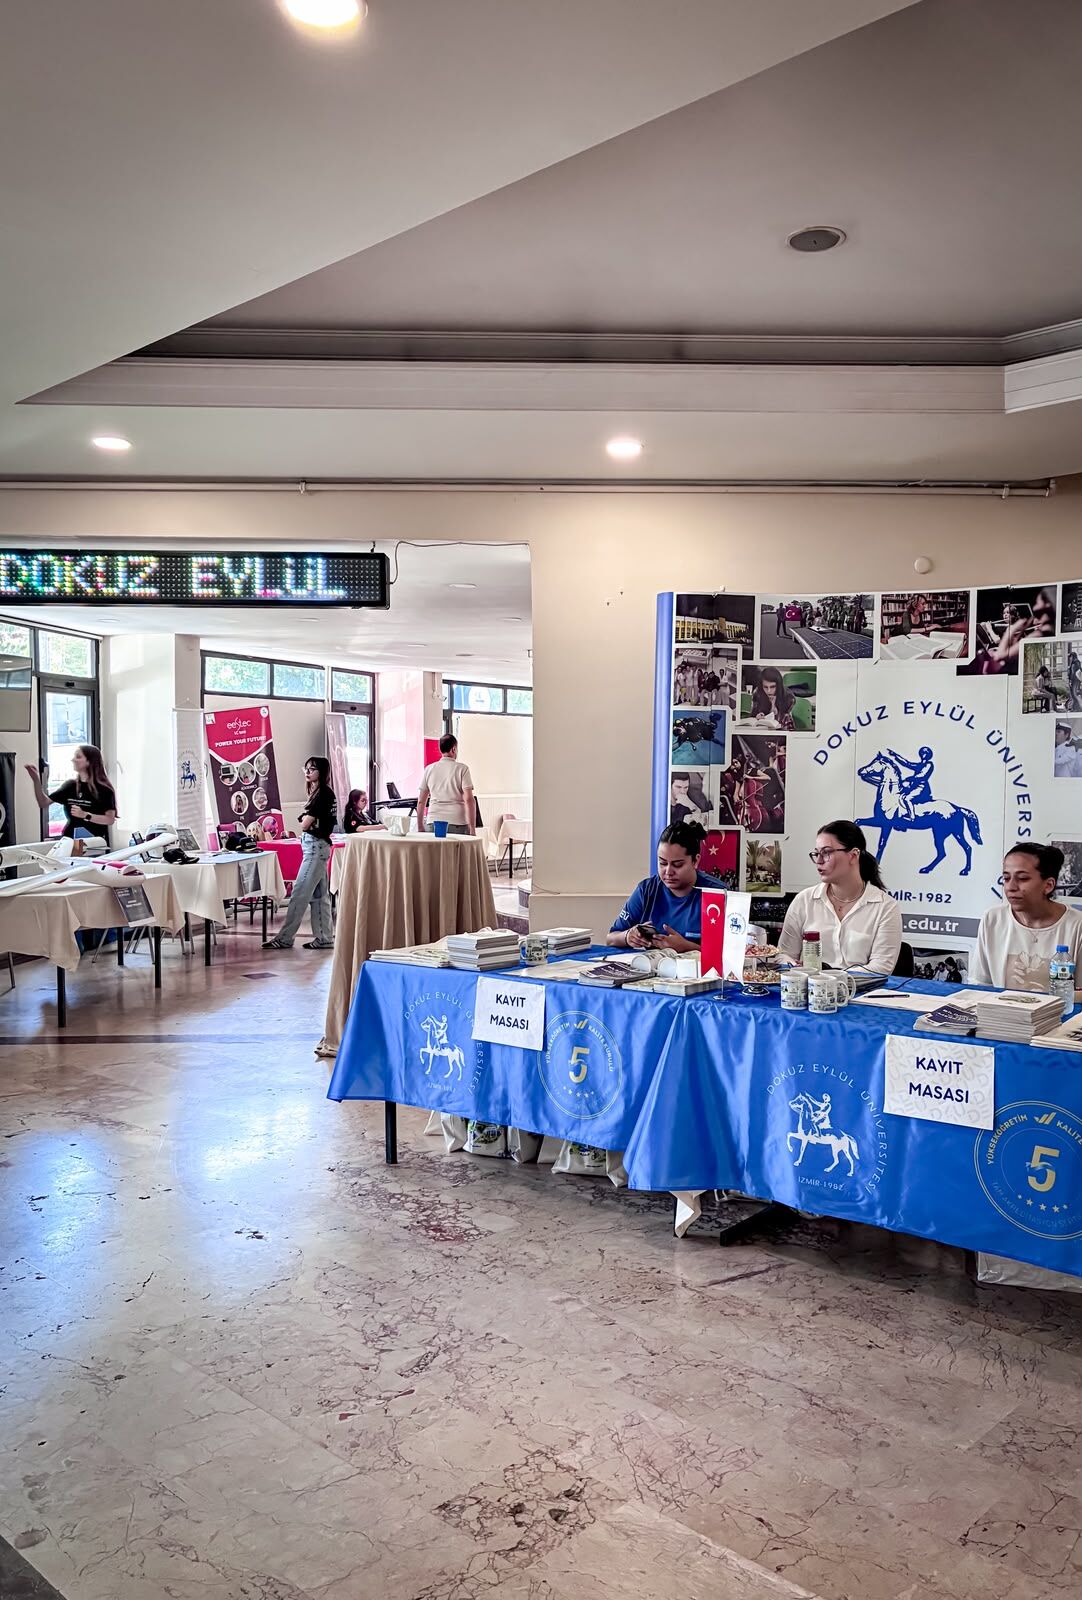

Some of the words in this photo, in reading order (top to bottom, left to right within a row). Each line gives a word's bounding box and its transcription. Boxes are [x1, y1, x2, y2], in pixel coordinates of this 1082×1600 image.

[0, 555, 159, 596] DOKUZ
[813, 704, 889, 766] DOKUZ
[903, 700, 975, 730] EYLÜL
[887, 889, 952, 903] MİR-1982
[903, 917, 959, 932] .edu.tr
[404, 992, 431, 1020] DOKUZ
[495, 993, 526, 1008] KAYIT
[490, 1013, 529, 1031] MASASI
[568, 1046, 590, 1084] 5
[916, 1056, 963, 1075] KAYIT
[766, 1064, 805, 1095] DOKUZ
[909, 1082, 969, 1104] MASASI
[1027, 1145, 1060, 1192] 5
